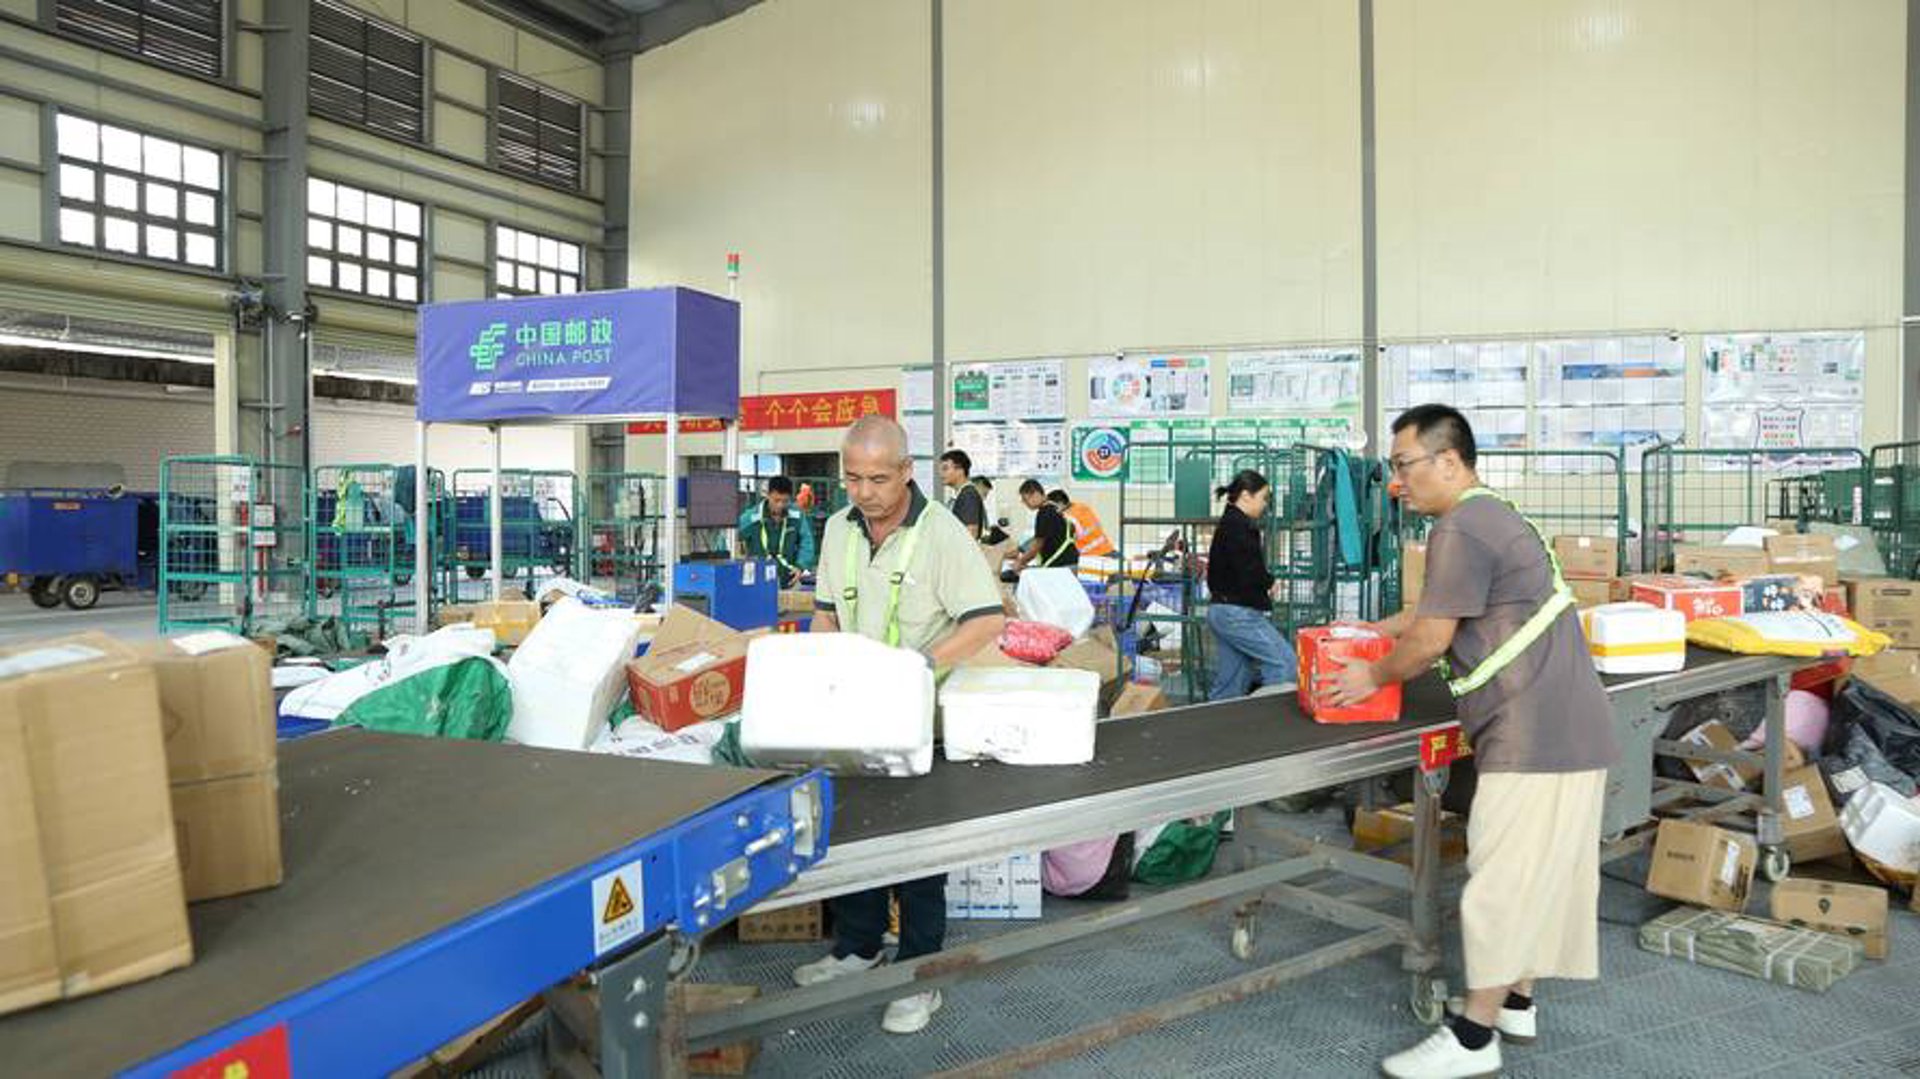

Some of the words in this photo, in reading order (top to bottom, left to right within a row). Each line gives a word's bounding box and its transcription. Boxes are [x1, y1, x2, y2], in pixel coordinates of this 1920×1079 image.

[515, 318, 612, 349] 中国邮政
[515, 351, 567, 367] CHINA
[571, 349, 613, 364] POST
